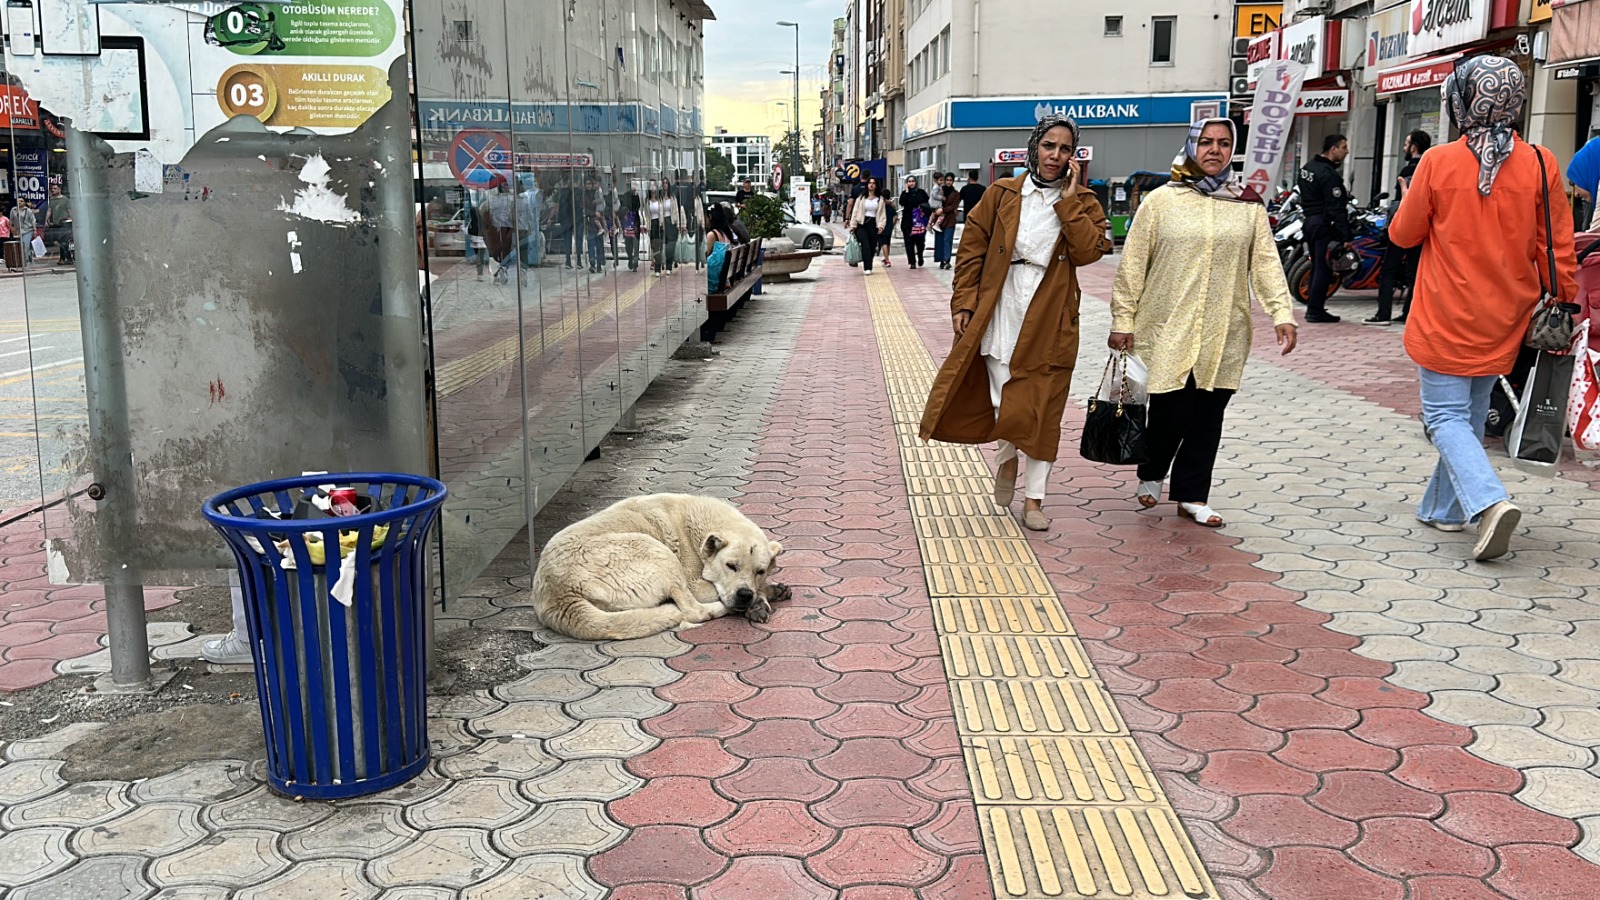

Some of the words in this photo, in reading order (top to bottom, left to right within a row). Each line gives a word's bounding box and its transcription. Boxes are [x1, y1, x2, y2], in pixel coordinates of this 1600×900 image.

[282, 4, 335, 14] OTOBÜSÜM
[338, 6, 380, 16] NEREDE?
[301, 73, 330, 82] AKILLI
[333, 73, 366, 82] DURAK
[230, 83, 264, 107] 03
[1304, 95, 1344, 110] arçelik
[1054, 103, 1140, 119] HALKBANK
[1252, 89, 1291, 164] DOĞRU
[13, 176, 40, 192] 00
[13, 191, 46, 200] İDİRİM
